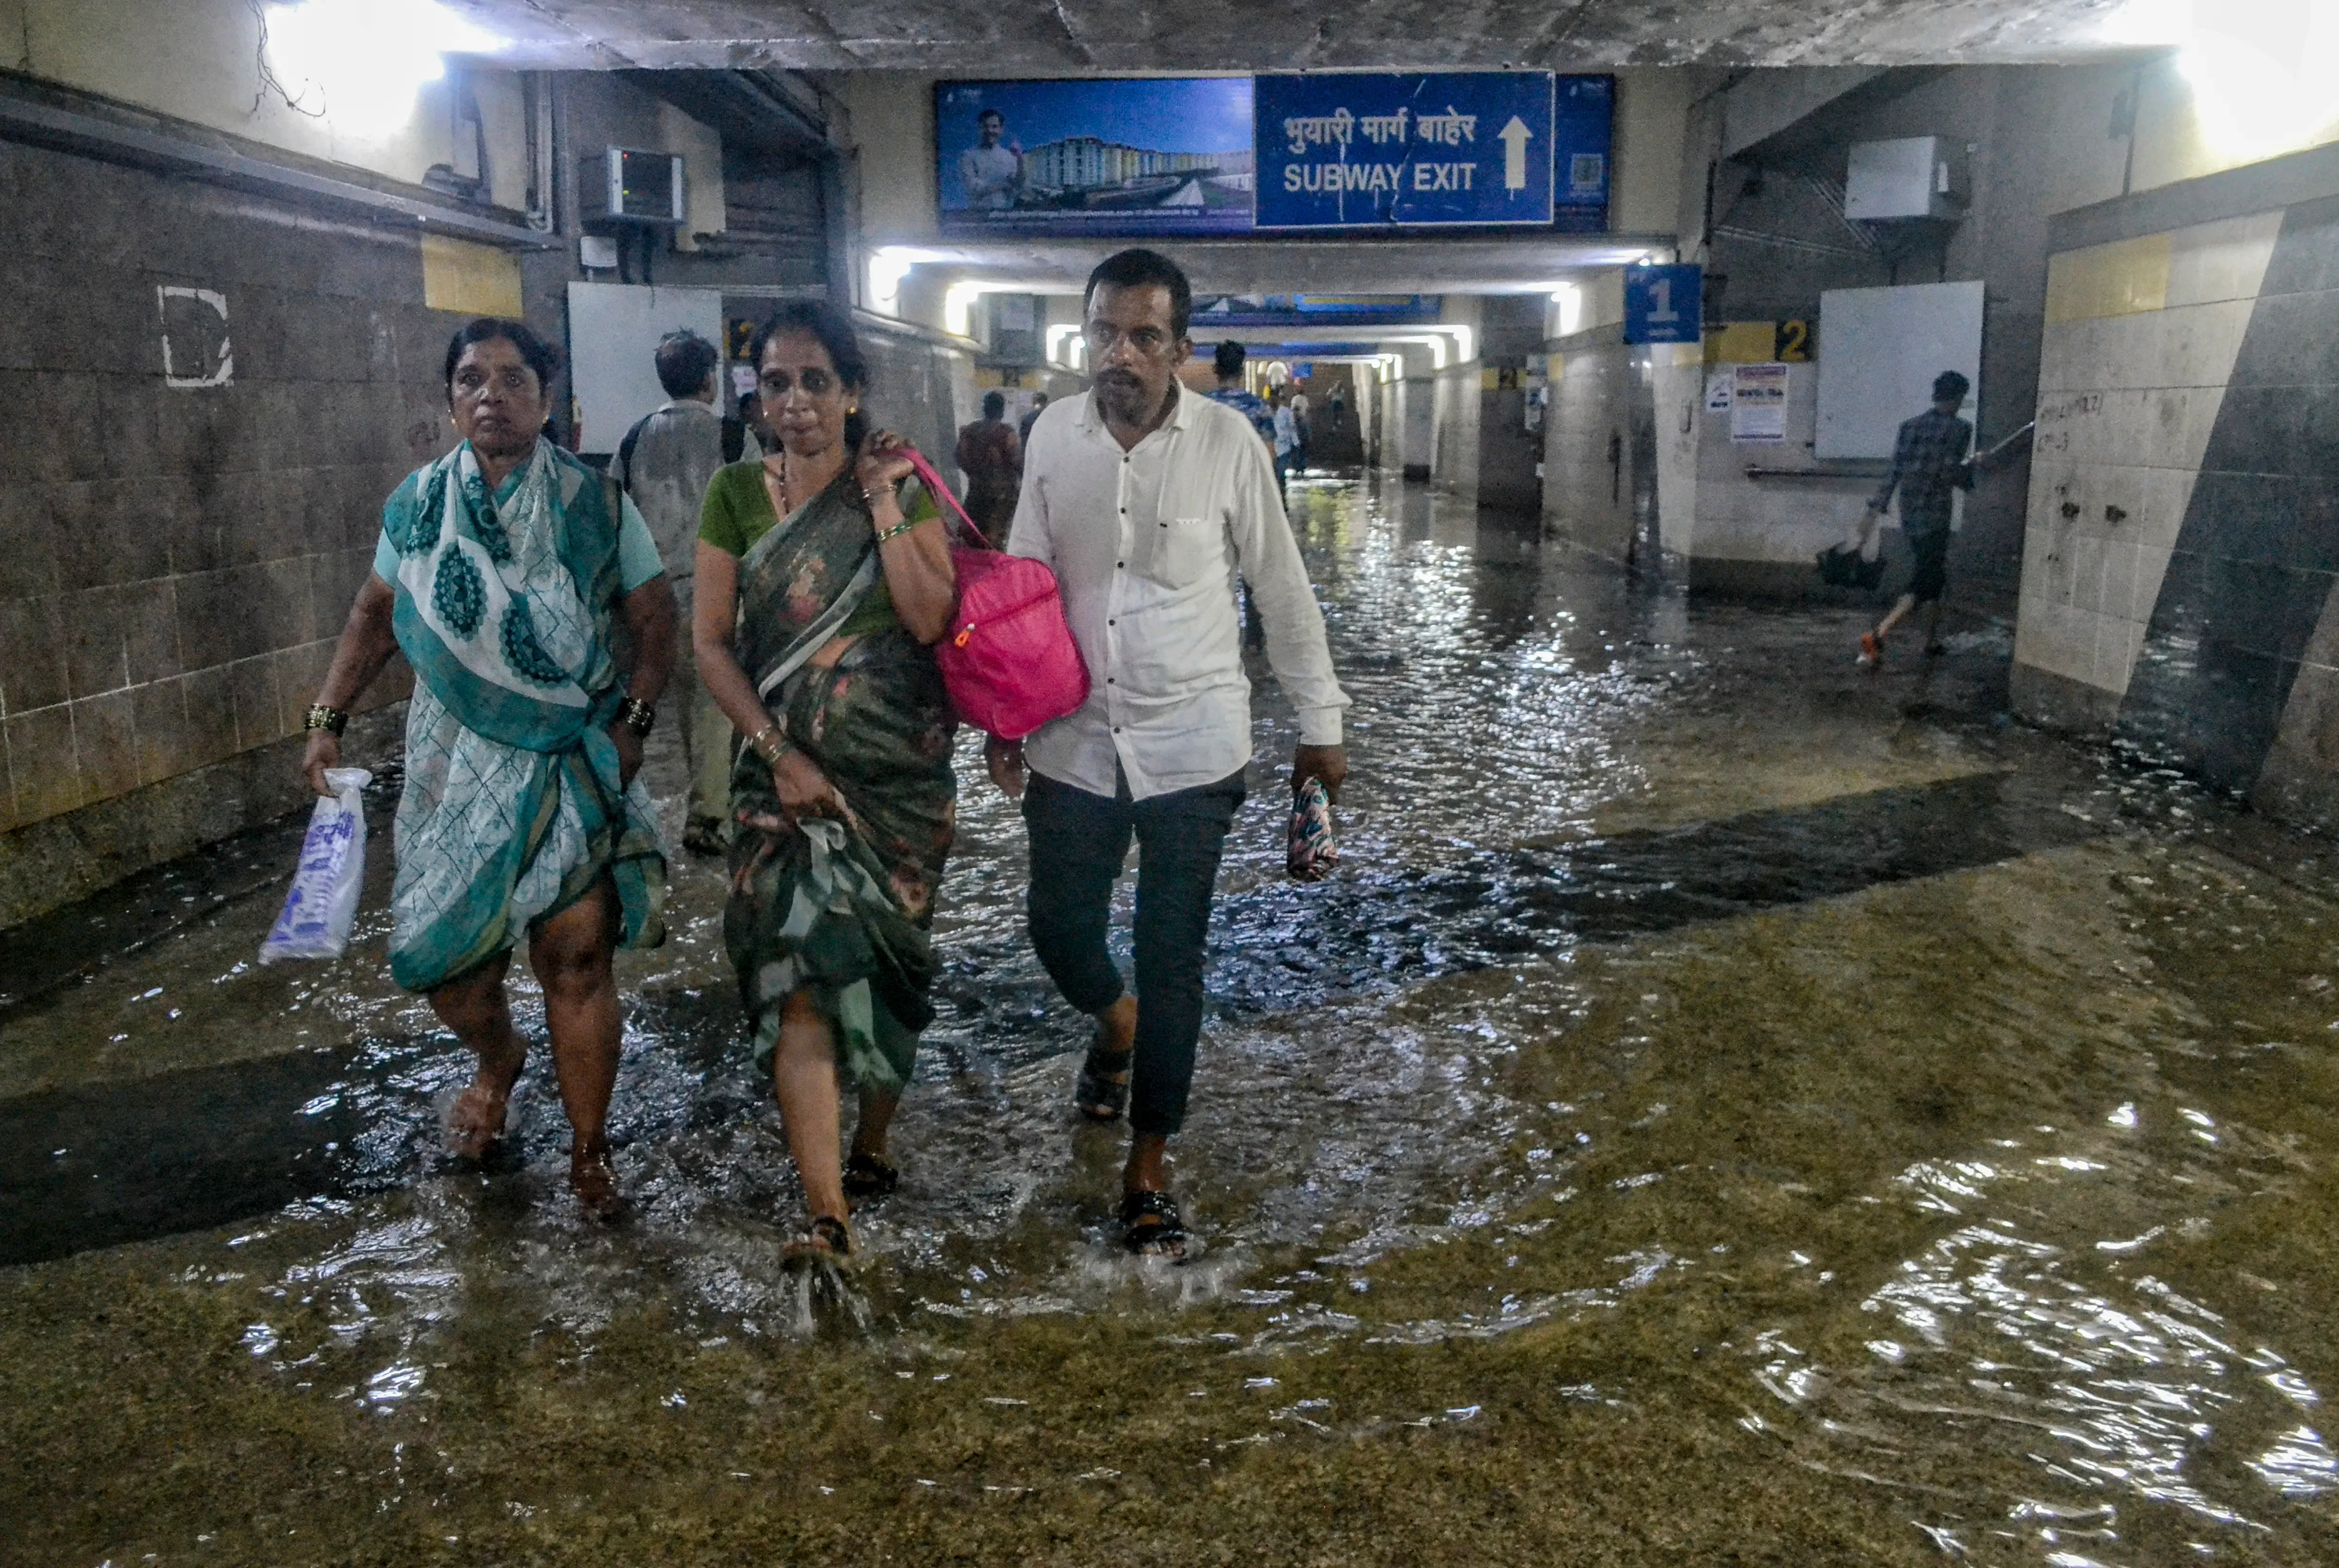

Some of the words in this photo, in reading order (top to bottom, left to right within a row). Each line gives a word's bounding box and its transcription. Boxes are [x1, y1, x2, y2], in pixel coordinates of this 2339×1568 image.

[1284, 107, 1355, 154] भुयारी
[1361, 106, 1408, 143] मार्ग
[1417, 104, 1476, 145] बाहेर
[1284, 163, 1403, 191] SUBWAY
[1414, 163, 1476, 191] EXIT
[1646, 278, 1679, 322] 1
[1782, 320, 1806, 361] 2
